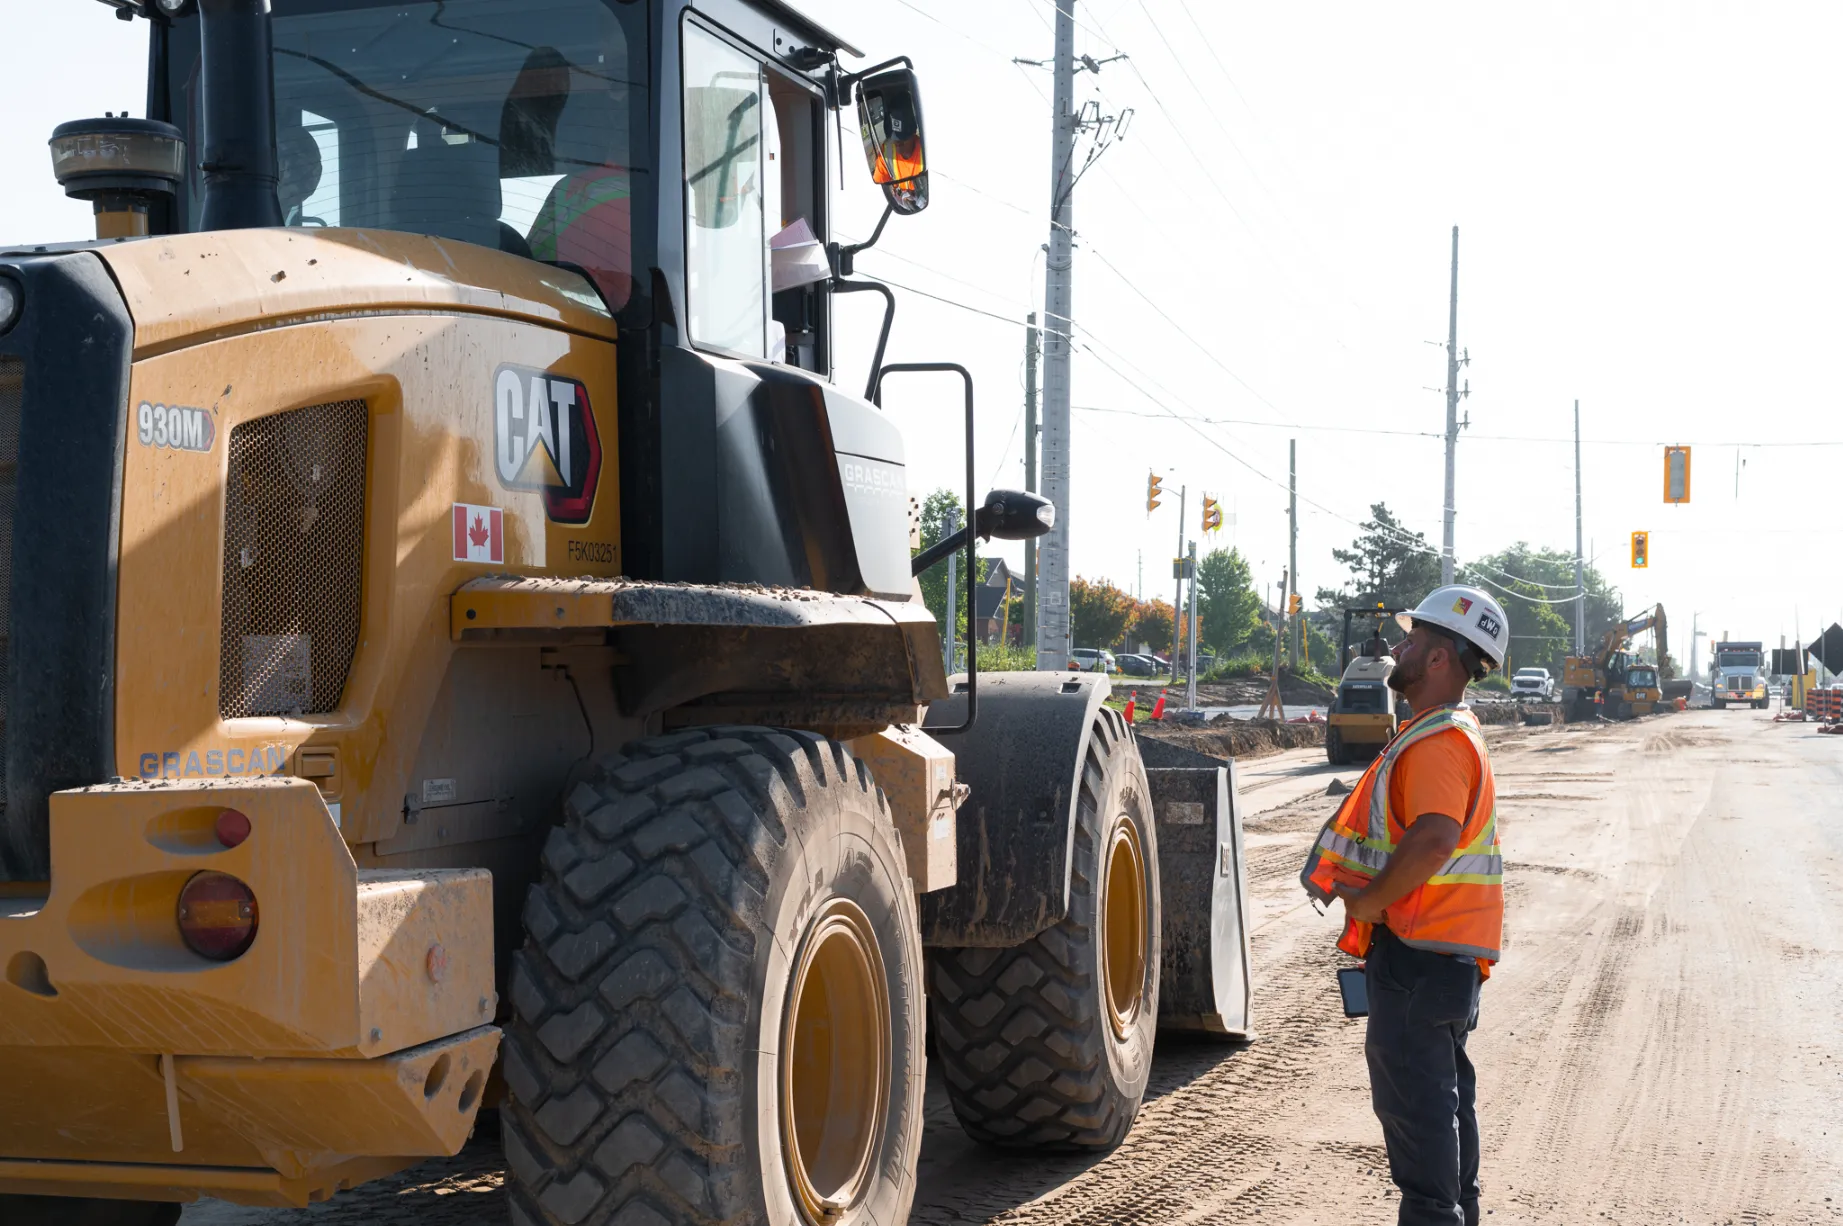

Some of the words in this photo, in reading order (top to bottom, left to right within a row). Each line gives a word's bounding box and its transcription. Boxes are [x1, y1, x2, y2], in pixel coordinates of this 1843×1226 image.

[139, 404, 203, 449] 930M
[496, 369, 576, 487] CAT
[568, 540, 617, 563] F5K03251
[139, 747, 285, 779] GRASCAN
